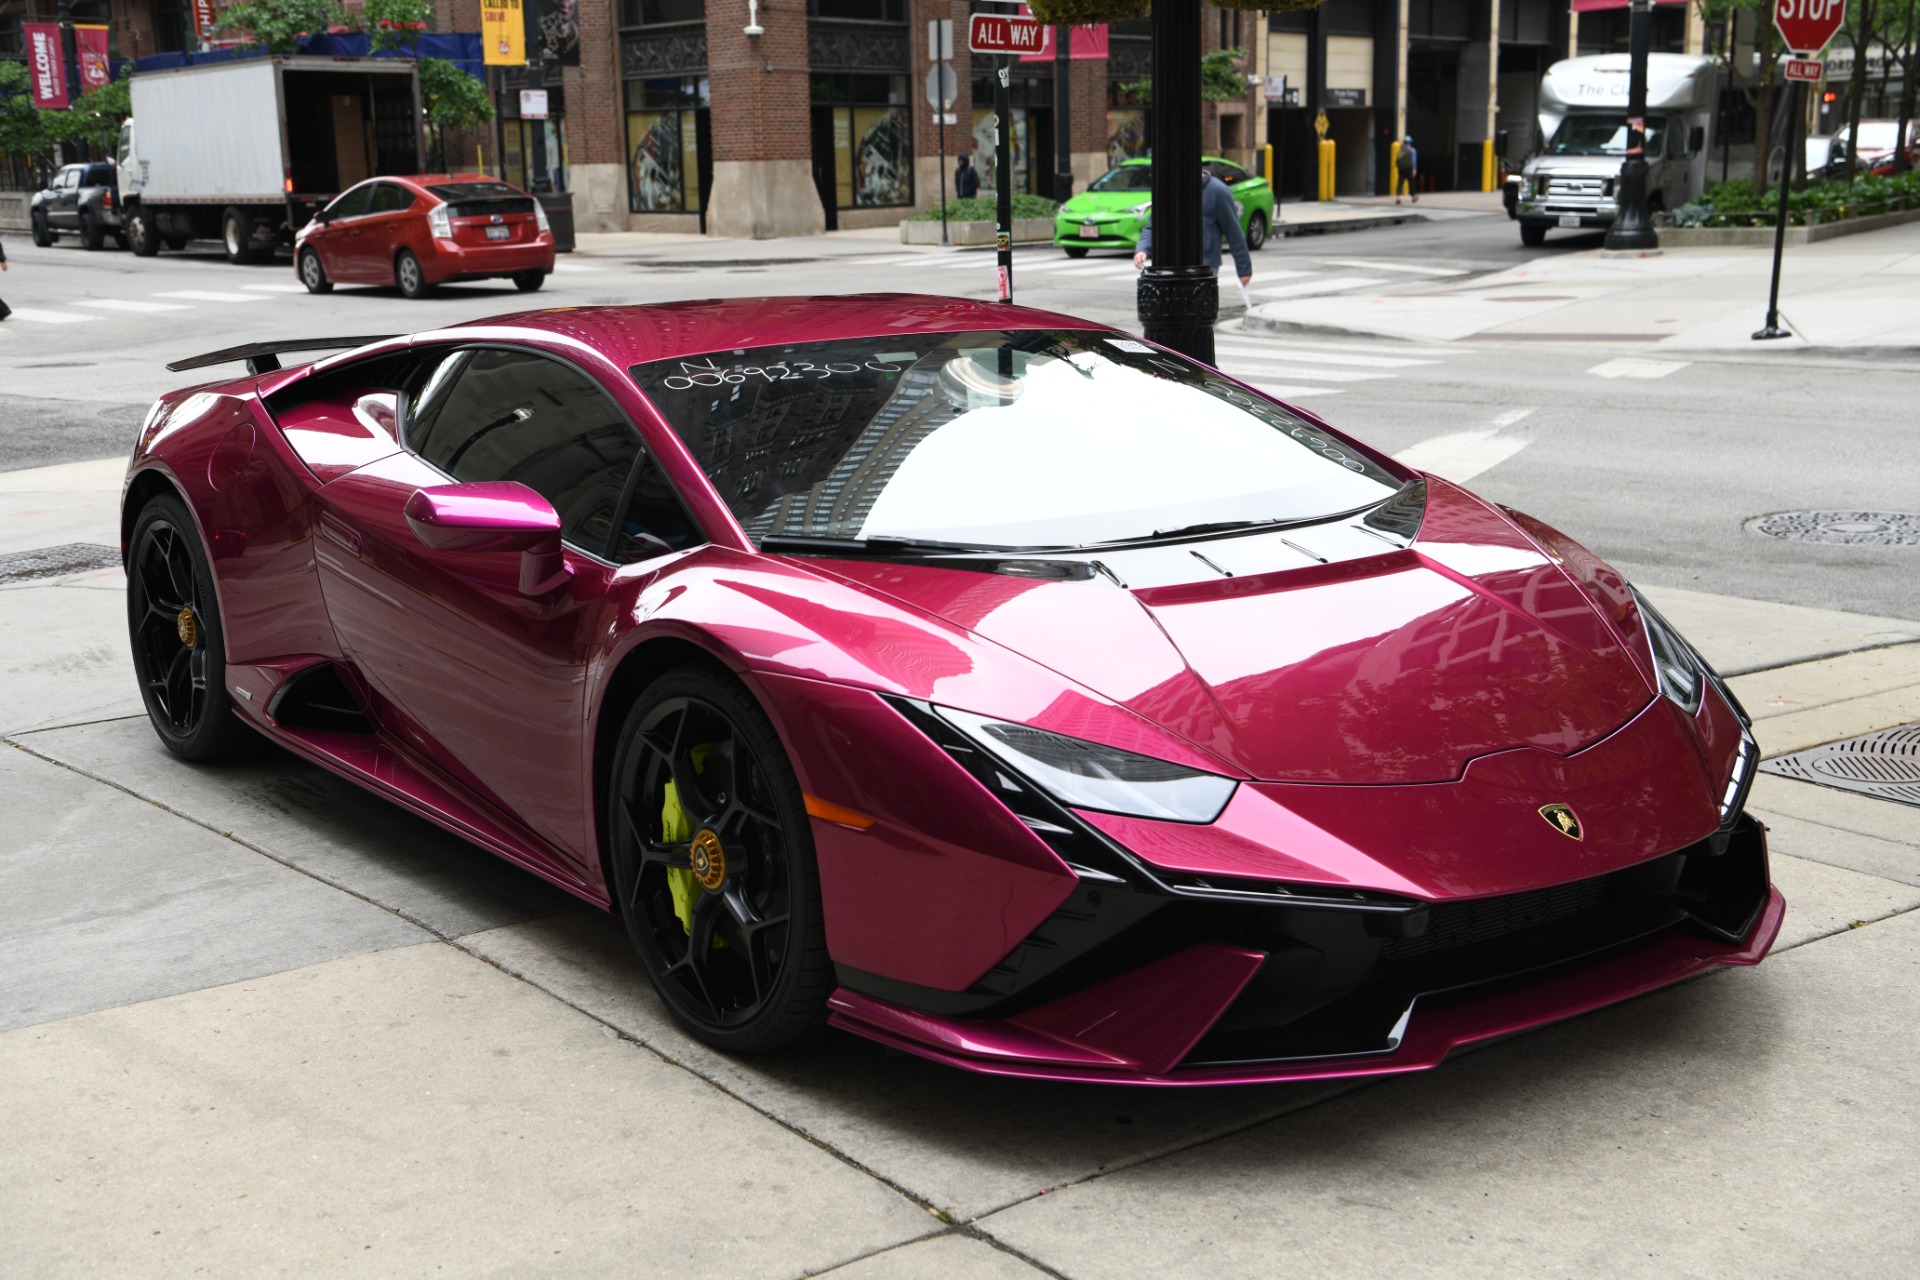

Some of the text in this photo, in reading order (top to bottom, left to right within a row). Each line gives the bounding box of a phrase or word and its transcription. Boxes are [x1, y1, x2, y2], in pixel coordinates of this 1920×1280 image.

[1780, 0, 1842, 20] STOP
[978, 23, 1004, 44] ALL
[1010, 25, 1037, 46] WAY
[33, 32, 53, 99] WELCOME
[1789, 63, 1819, 76] ALL WAY
[1579, 84, 1629, 95] The Cl
[664, 361, 901, 389] 00692300
